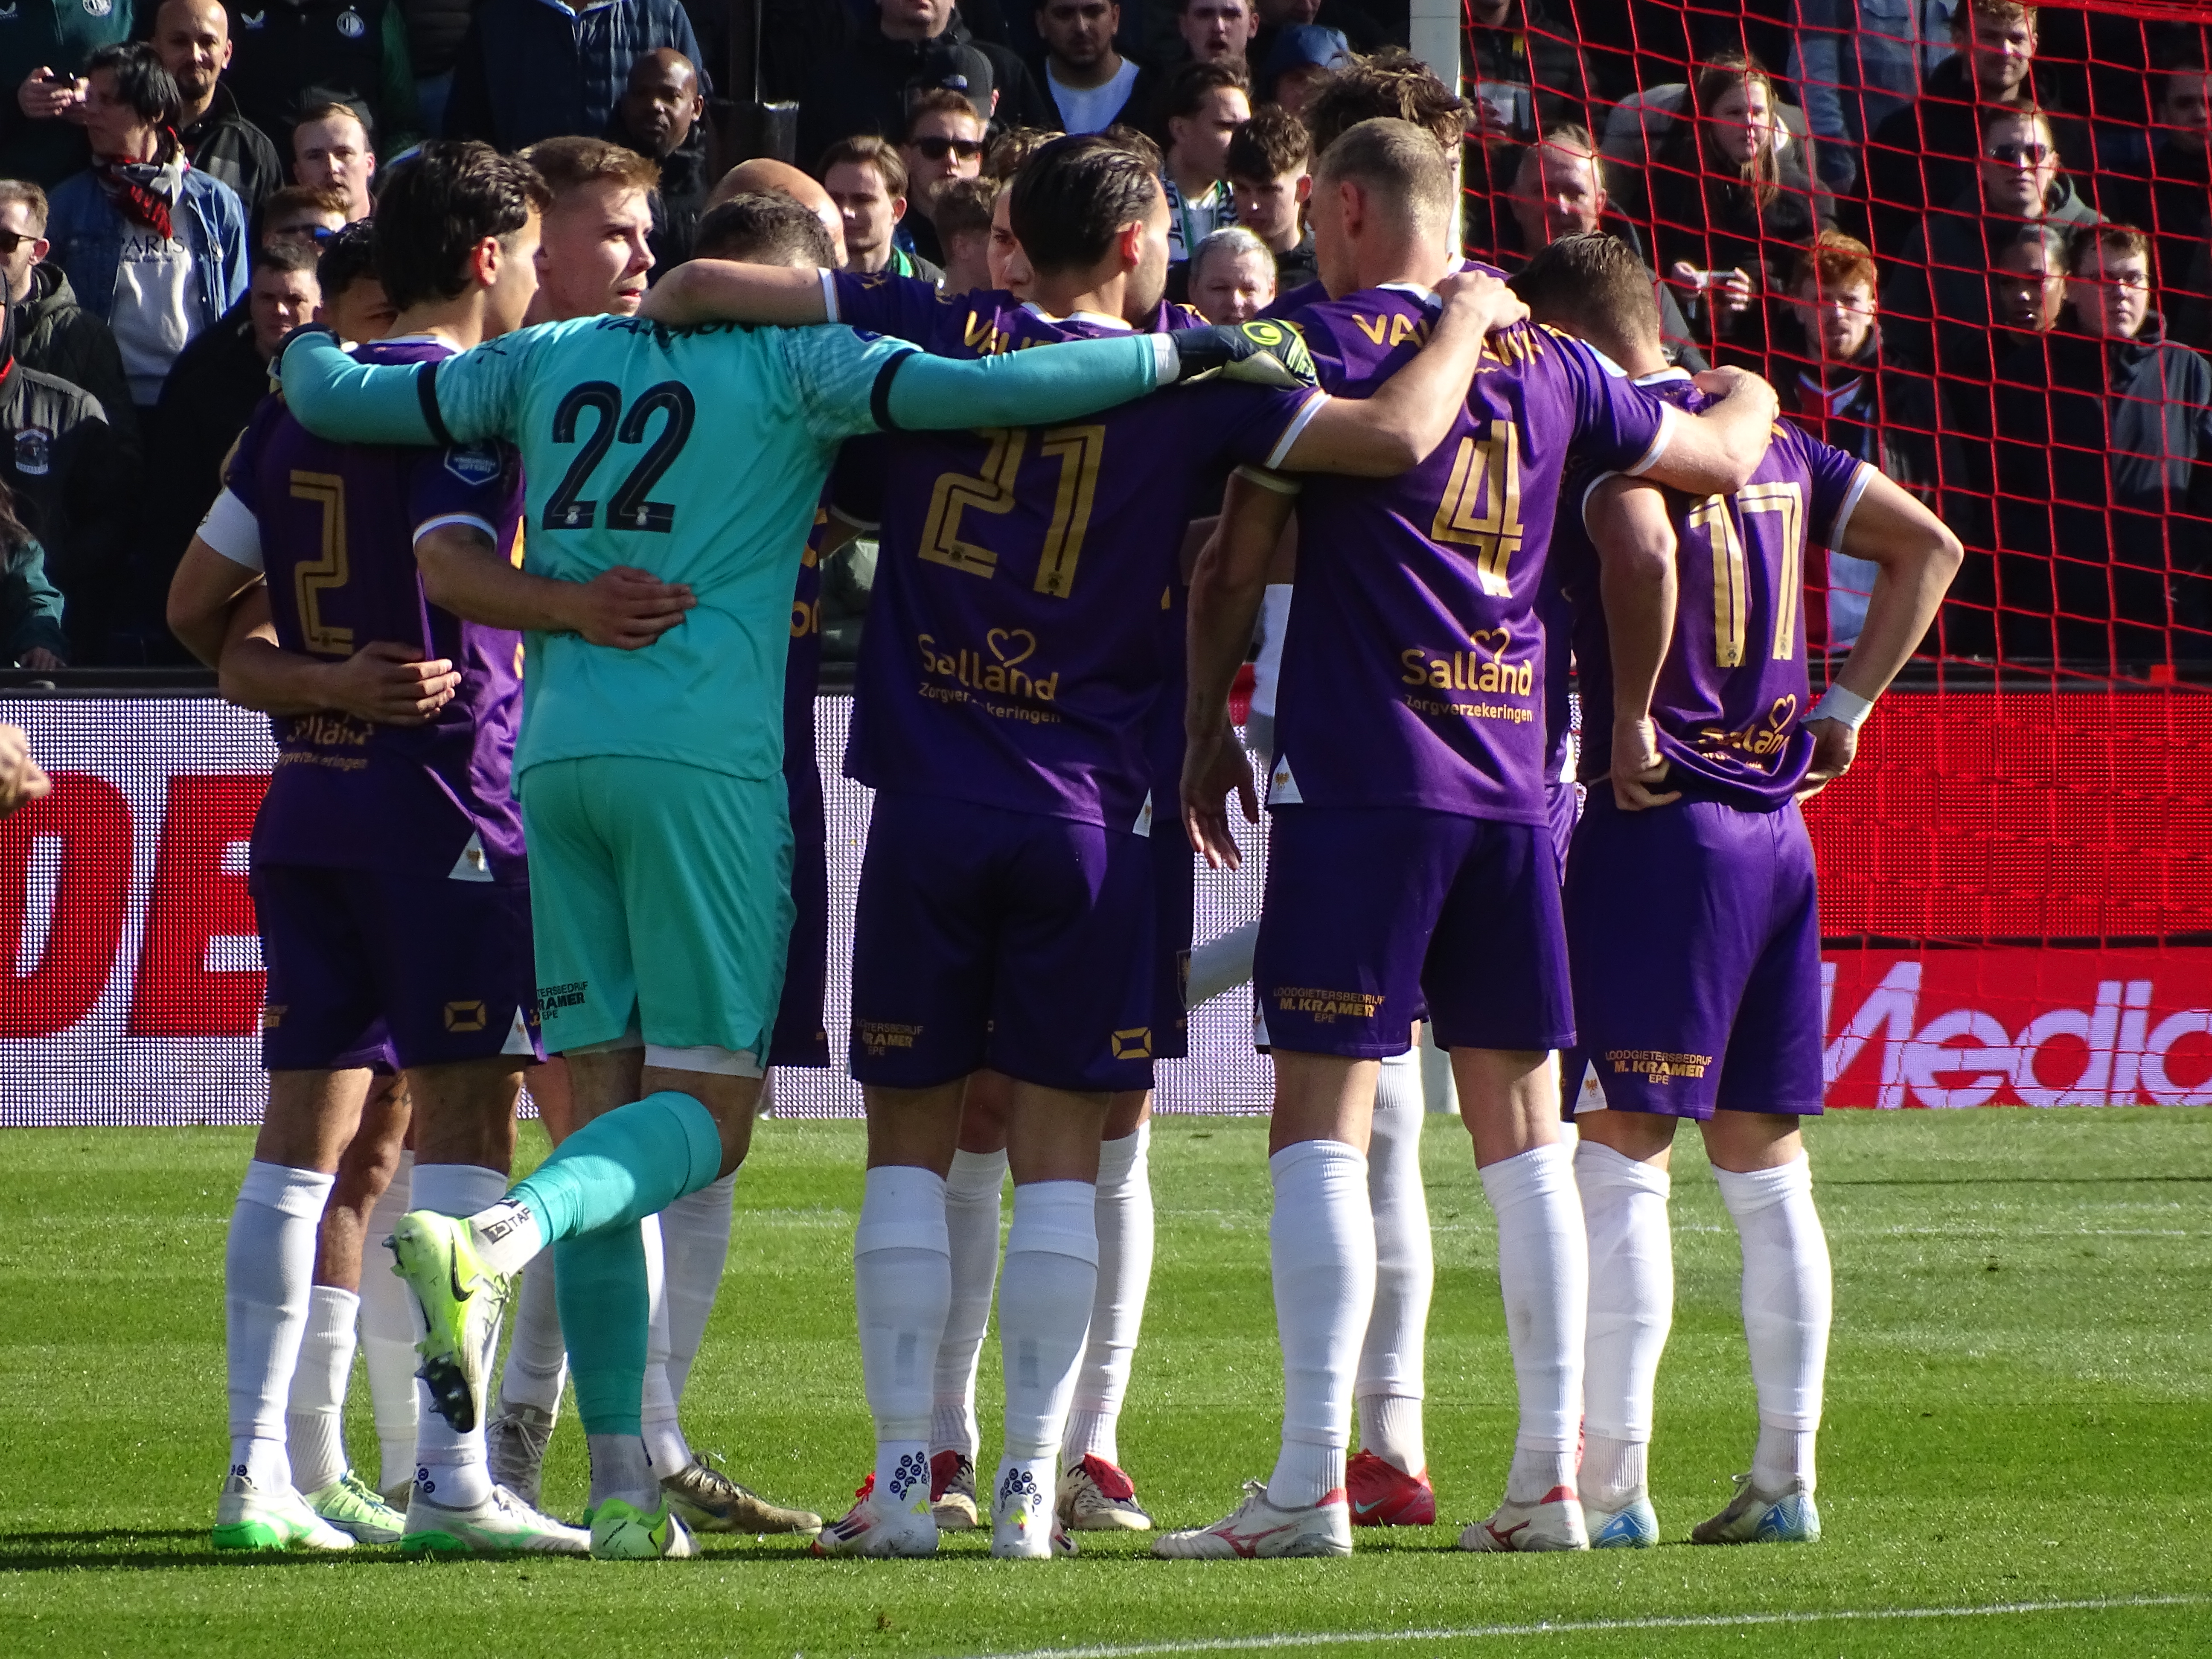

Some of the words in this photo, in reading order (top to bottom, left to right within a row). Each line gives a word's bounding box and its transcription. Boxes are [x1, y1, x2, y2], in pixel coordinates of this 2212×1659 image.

[542, 380, 696, 533] 22
[918, 425, 1105, 598] 27
[1431, 419, 1524, 598] 4
[290, 470, 355, 656] 2
[1689, 481, 1802, 667] 17
[918, 634, 1059, 701] Salland
[1401, 648, 1533, 696] Salland
[1405, 694, 1533, 724] Zorgverzekeringen
[542, 1009, 559, 1020] EPE
[1298, 998, 1376, 1018] KRAMER
[1314, 1013, 1335, 1023] EPE
[1632, 1061, 1705, 1078] KRAMER
[1649, 1074, 1669, 1085] EPE
